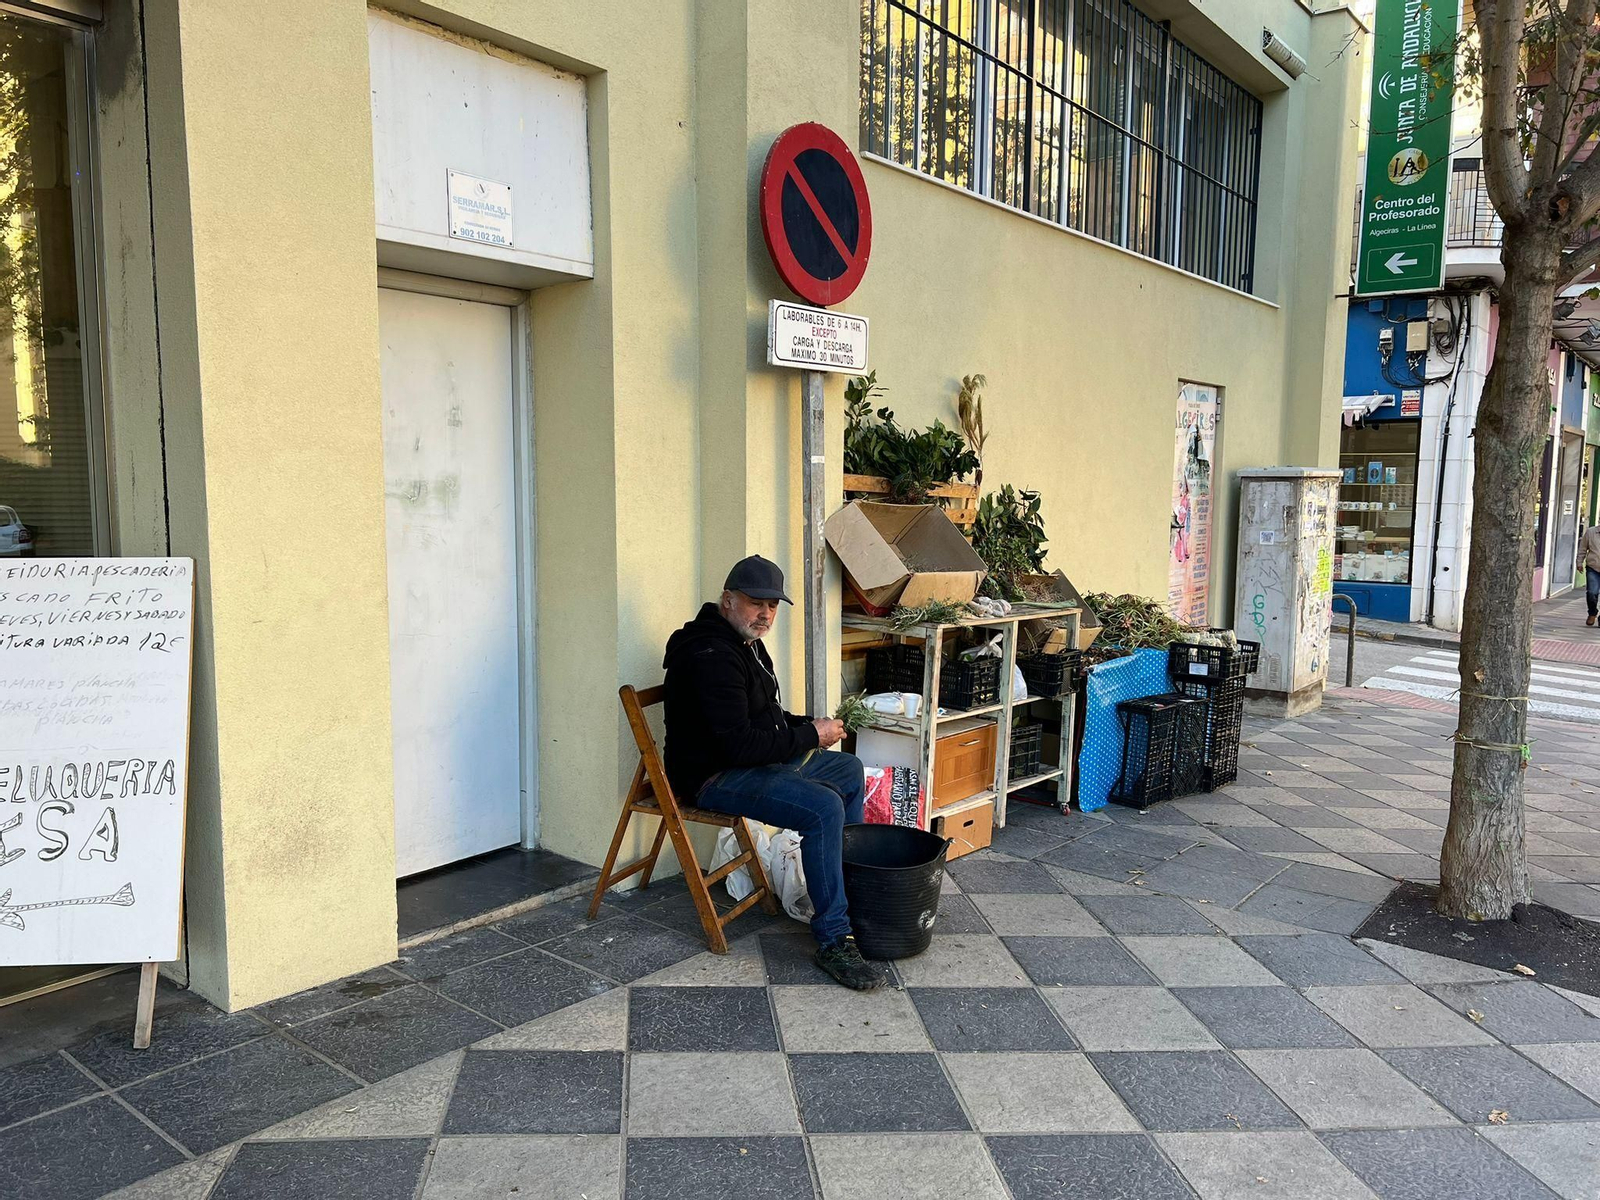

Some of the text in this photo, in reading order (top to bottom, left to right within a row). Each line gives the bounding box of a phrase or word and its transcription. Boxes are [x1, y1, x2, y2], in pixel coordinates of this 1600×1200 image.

[1402, 0, 1422, 70] ANDALUCI
[1400, 74, 1418, 94] DE
[1396, 98, 1416, 144] JUNTA
[1374, 193, 1435, 210] Centro del
[1368, 205, 1441, 222] Profesorado
[460, 227, 505, 244] 902 102 204
[1369, 227, 1400, 238] Algeciras
[1407, 225, 1416, 233] La
[782, 309, 824, 326] LABORABLES
[827, 317, 835, 328] DE
[844, 320, 849, 330] A
[811, 326, 838, 340] EXCEPTO
[792, 336, 853, 353] CARGA Y DESCARGA
[791, 348, 854, 365] MAXIMO 30 MINUTOS
[0, 591, 71, 604] SCADO
